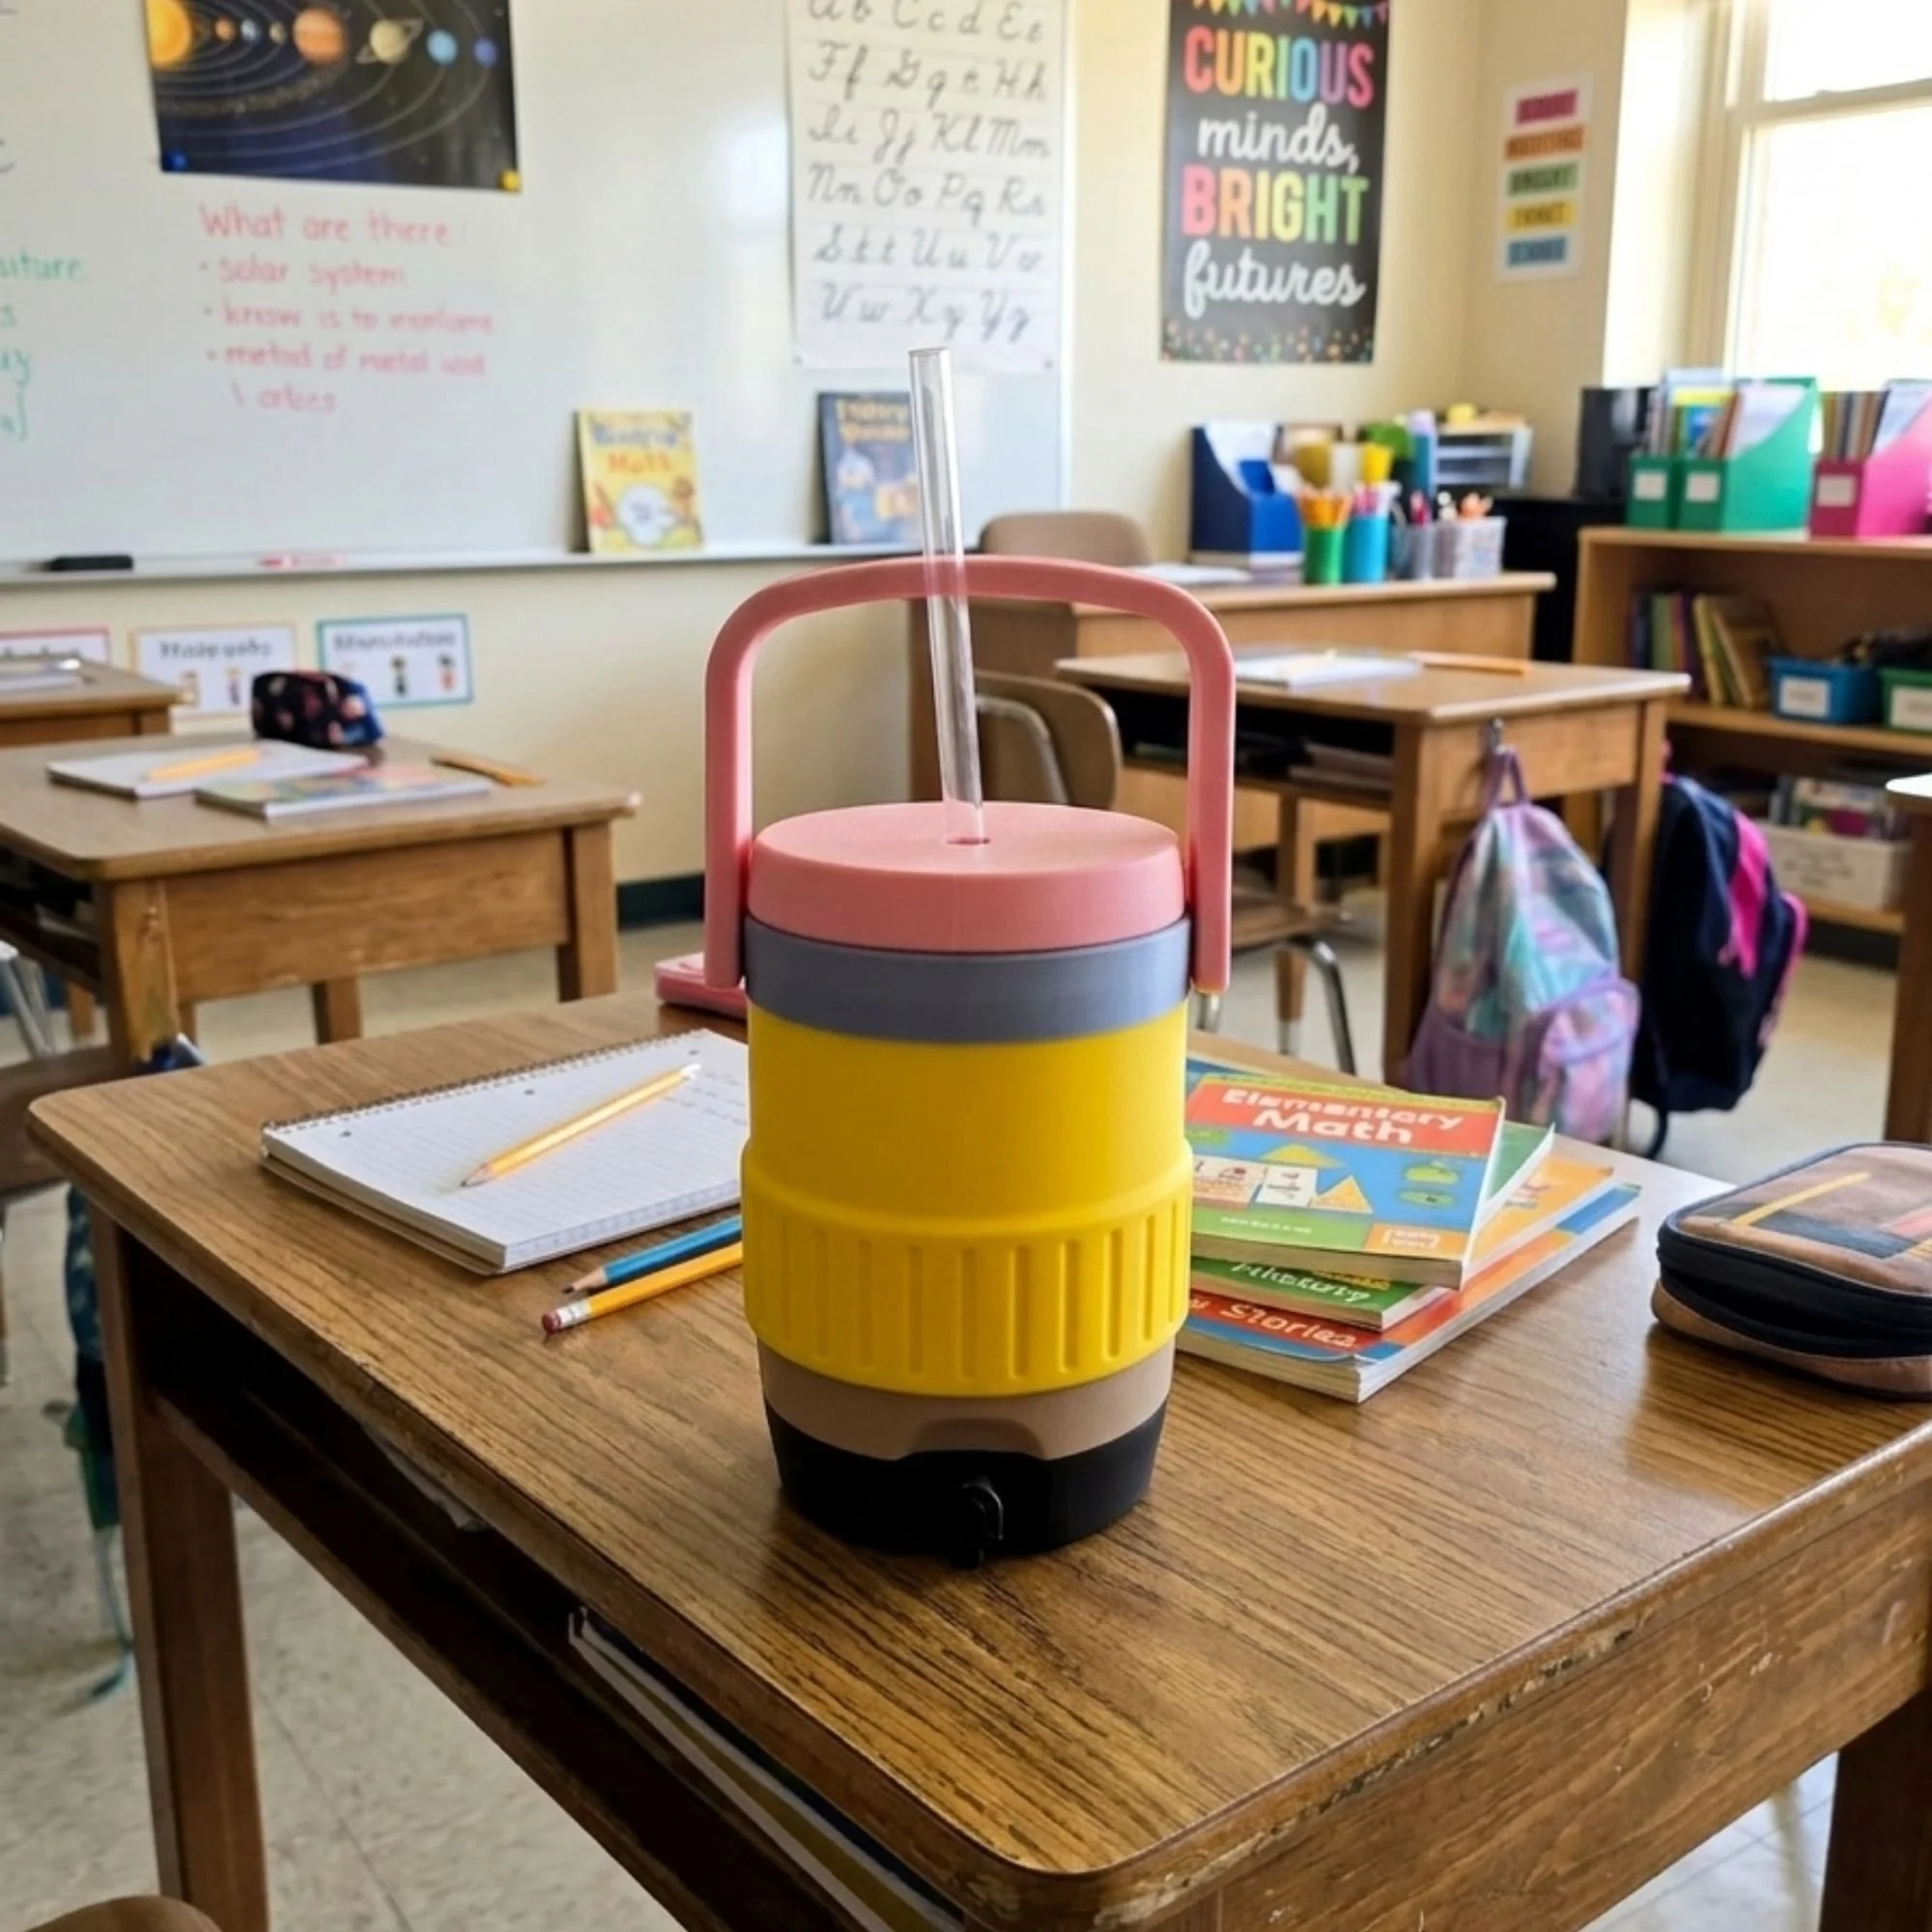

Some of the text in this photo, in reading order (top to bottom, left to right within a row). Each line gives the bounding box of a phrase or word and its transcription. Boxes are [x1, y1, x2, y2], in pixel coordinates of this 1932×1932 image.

[1184, 25, 1375, 107] CURIOUS
[1197, 102, 1359, 174] minds,
[199, 201, 452, 248] What are there
[1181, 164, 1370, 245] BRIGHT
[1183, 240, 1366, 319] futures
[1222, 1089, 1464, 1130] Elementary
[1253, 1109, 1413, 1145] Math
